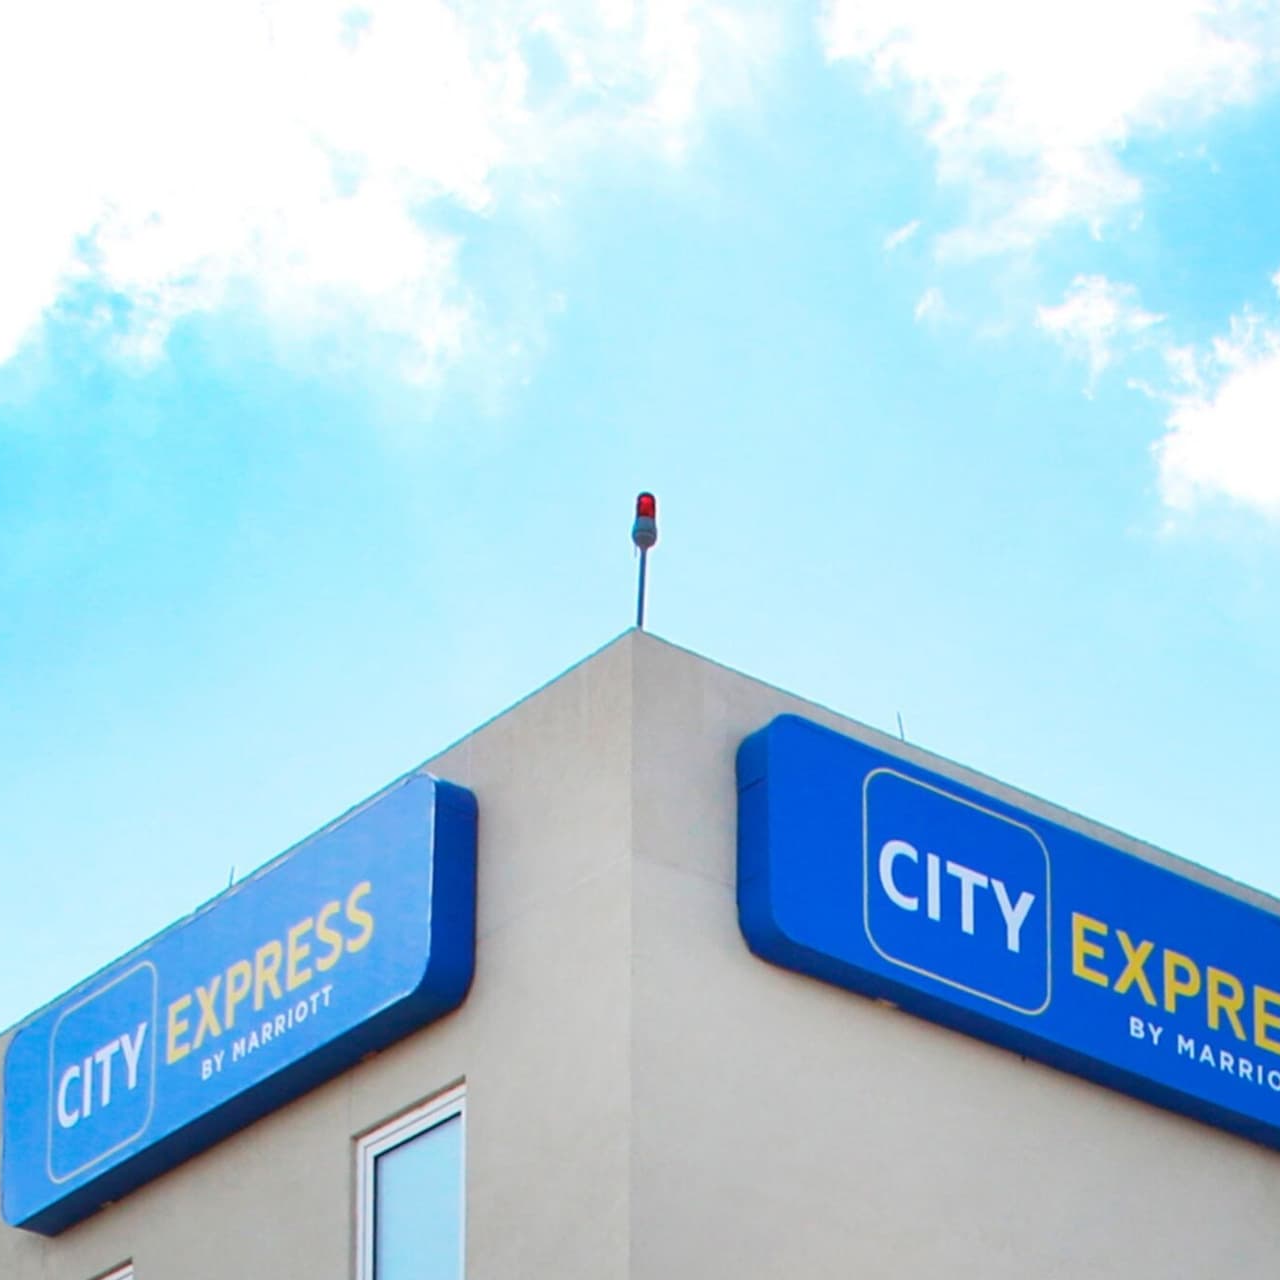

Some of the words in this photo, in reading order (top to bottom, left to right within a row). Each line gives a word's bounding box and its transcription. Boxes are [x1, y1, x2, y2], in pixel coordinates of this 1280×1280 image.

[878, 839, 1035, 954] CITY
[57, 1022, 148, 1128] CITY
[166, 881, 374, 1065] EXPRESS
[201, 1051, 226, 1081] BY
[232, 984, 334, 1062] MARRIOTT
[1129, 1016, 1164, 1046] BY
